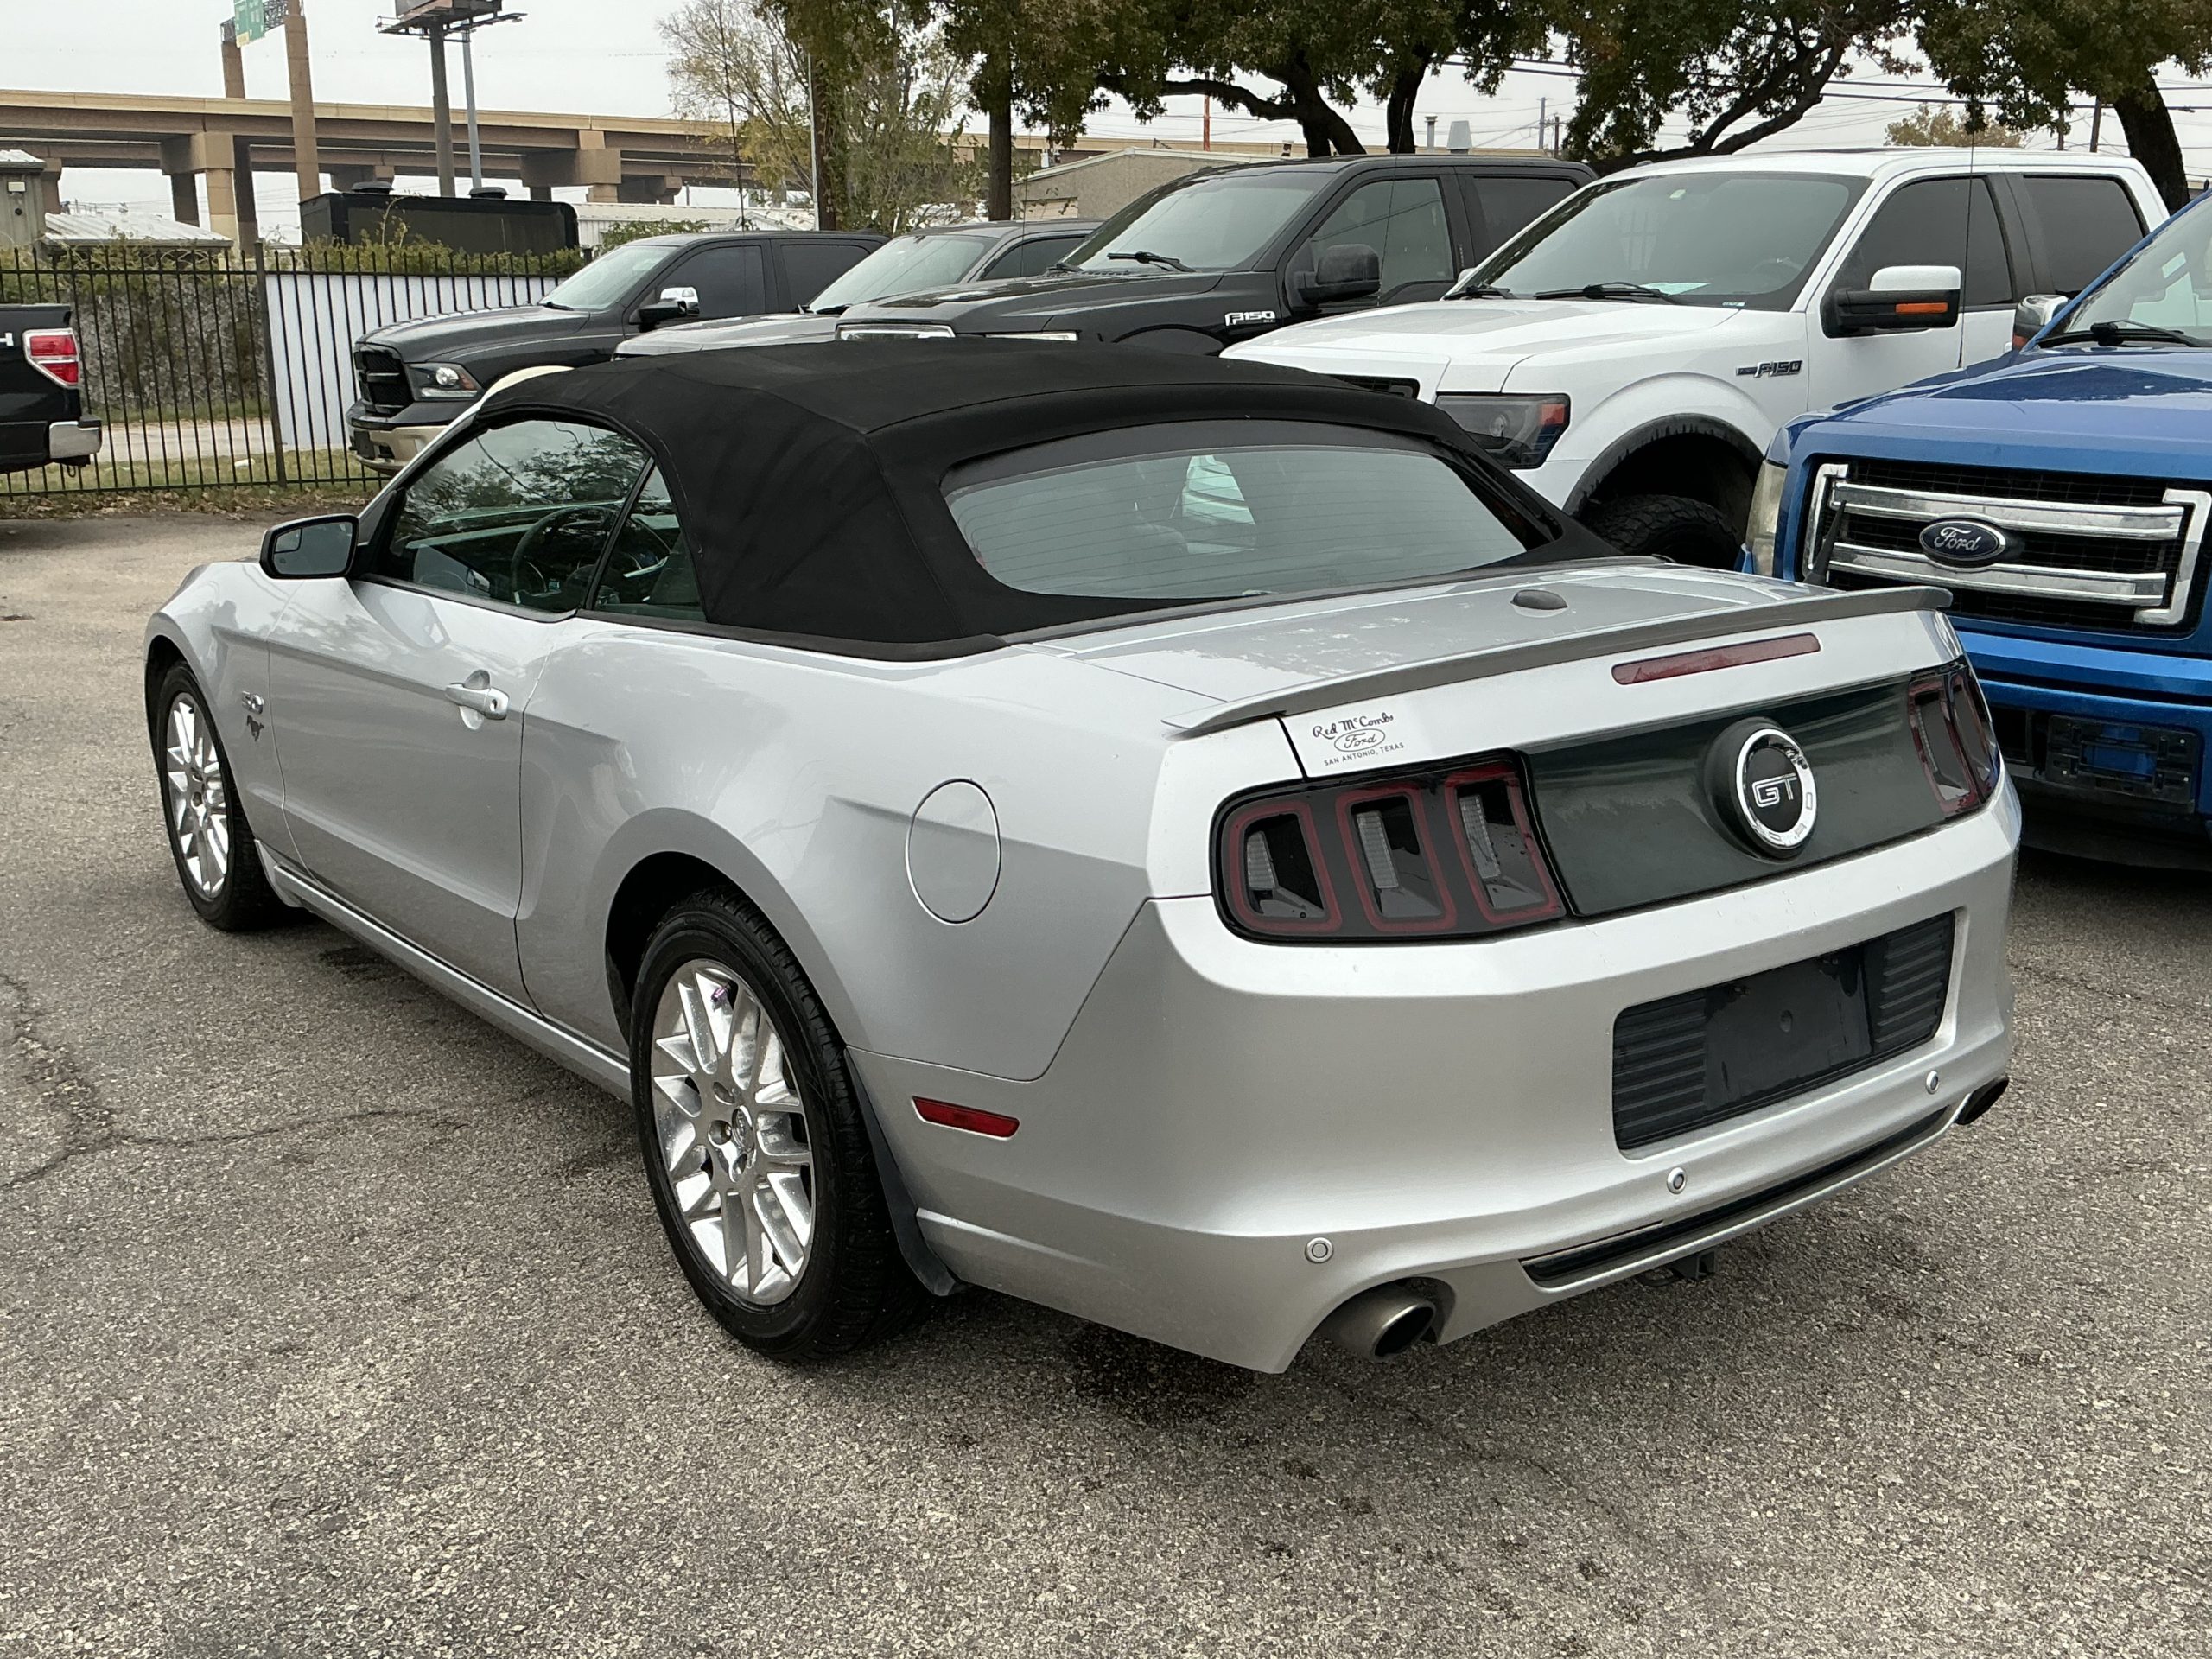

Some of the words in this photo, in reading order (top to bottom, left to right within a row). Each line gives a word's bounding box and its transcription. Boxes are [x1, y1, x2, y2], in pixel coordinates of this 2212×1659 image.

[1934, 526, 1982, 551] Ford
[1313, 723, 1338, 740] Red
[1344, 732, 1377, 749] Ford
[1324, 758, 1339, 766] SAN
[1342, 749, 1378, 761] ANTONIO,
[1379, 742, 1404, 753] TEXAS
[1751, 772, 1797, 808] GT
